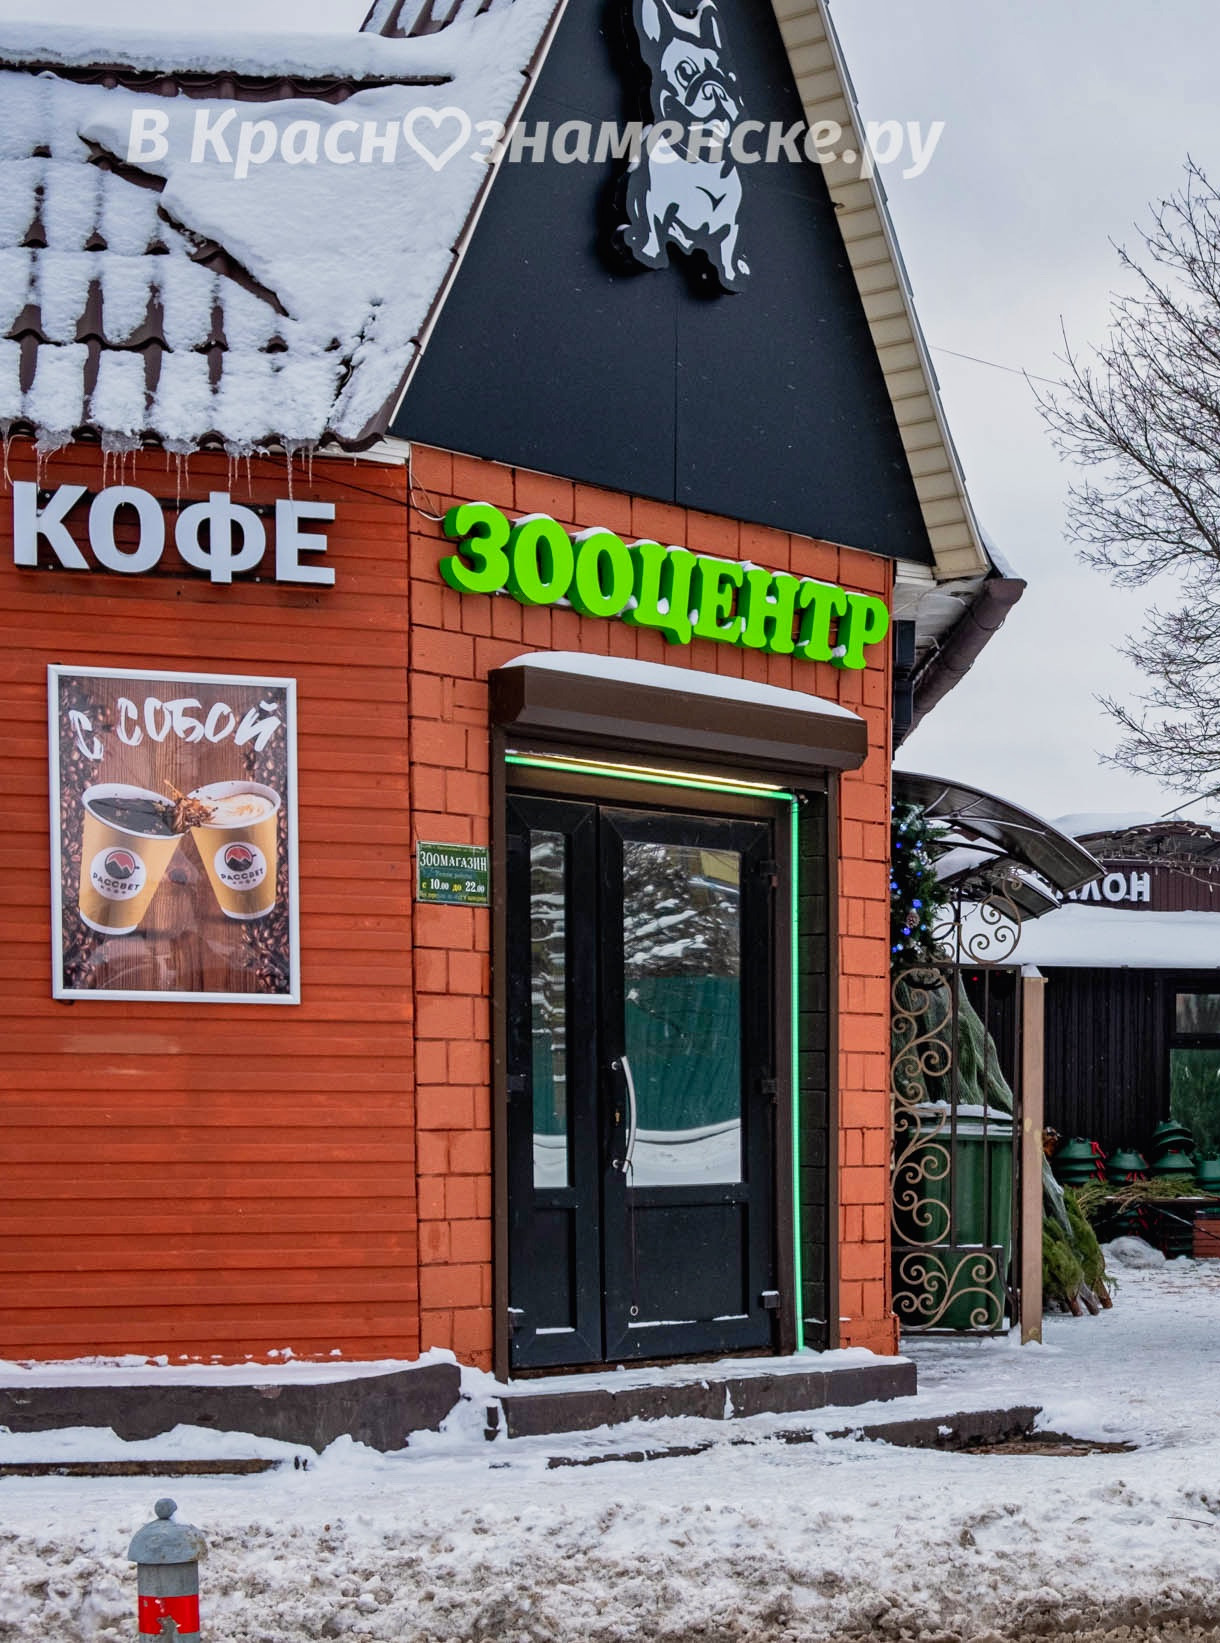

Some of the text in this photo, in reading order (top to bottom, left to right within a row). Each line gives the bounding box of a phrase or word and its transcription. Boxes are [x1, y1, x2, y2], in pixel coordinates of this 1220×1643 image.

[14, 481, 336, 584] КОФЕ
[440, 502, 890, 670] ЗООЦЕНТР
[117, 697, 281, 752] СОБОЙ
[419, 850, 487, 871] ЗООМАГАЗИН
[92, 872, 140, 891] РАССВЕТ
[220, 867, 264, 881] РАССВЕТ
[430, 878, 450, 891] 10.00
[452, 883, 462, 892] до
[465, 880, 485, 893] 22.00
[1056, 871, 1150, 902] ЛОН
